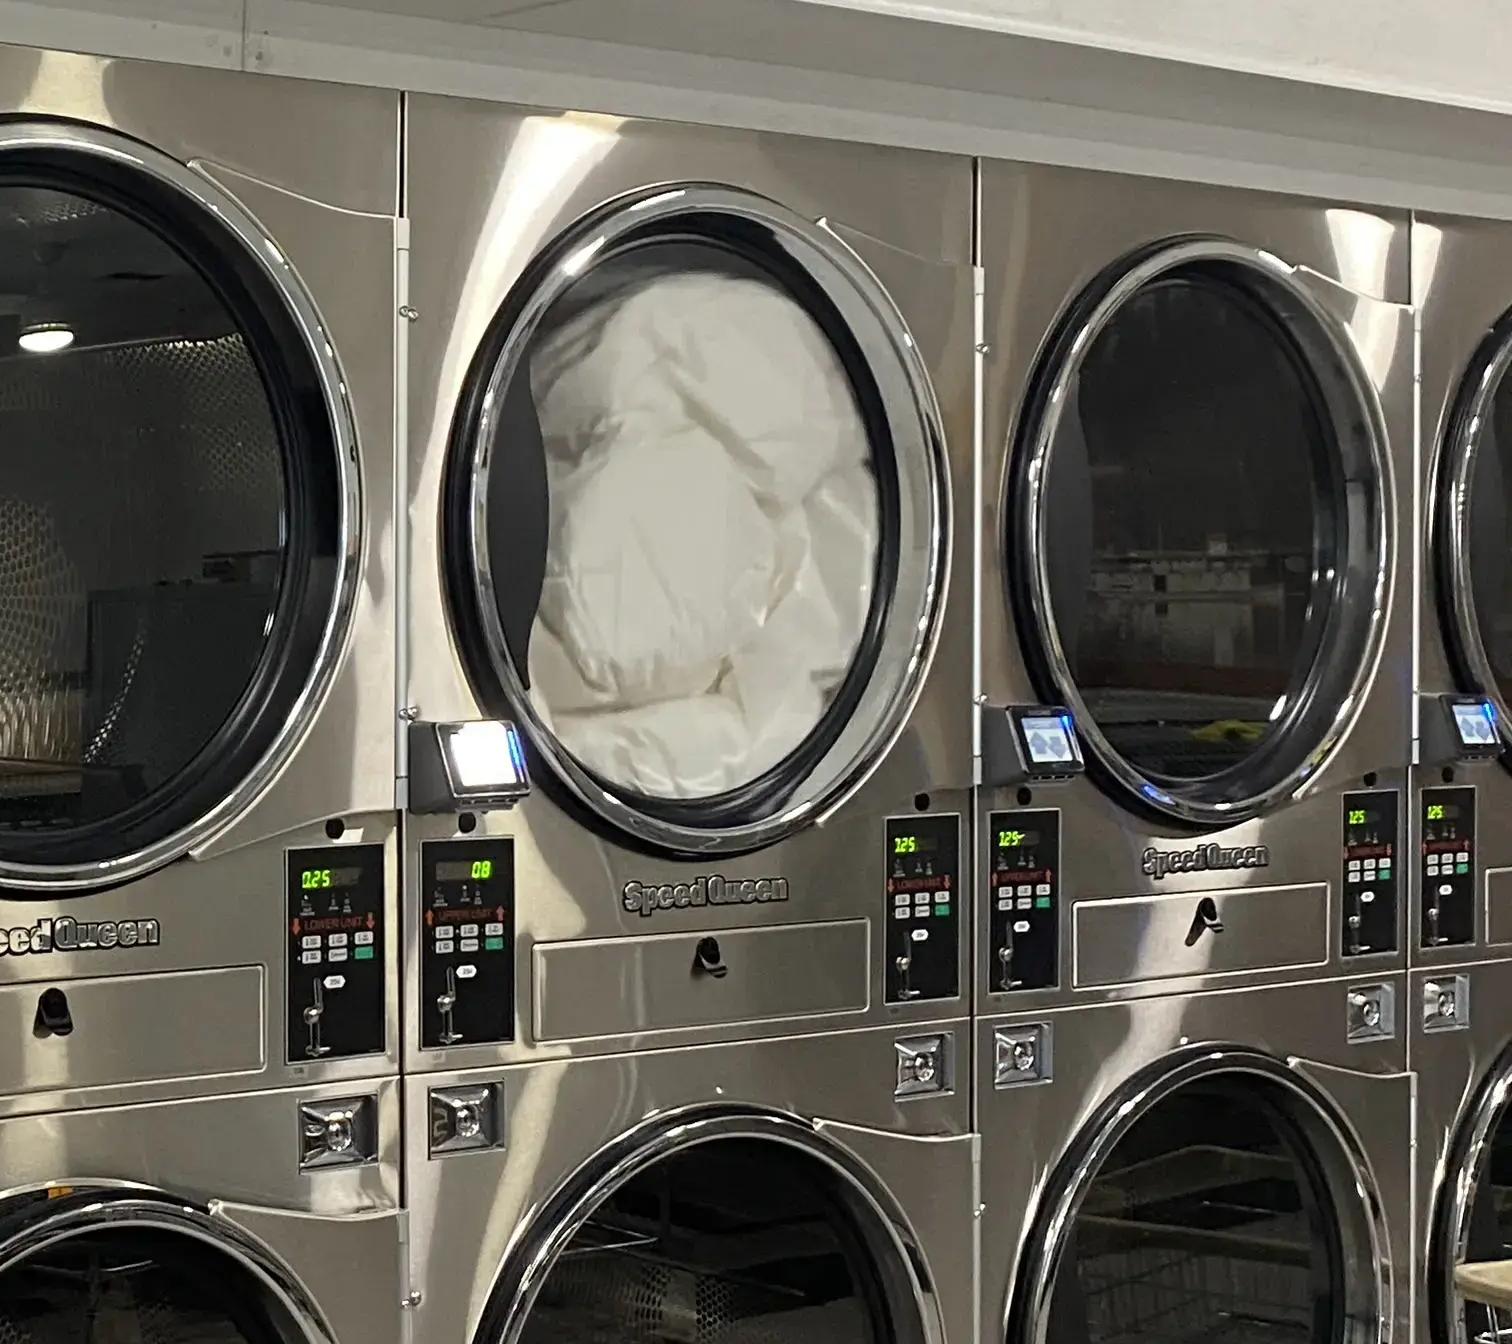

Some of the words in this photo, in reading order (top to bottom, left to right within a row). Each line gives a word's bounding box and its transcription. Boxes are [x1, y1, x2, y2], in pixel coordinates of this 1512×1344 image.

[1142, 844, 1208, 880] Speed
[1207, 842, 1269, 871] Queen
[623, 876, 707, 917] Speed
[707, 874, 789, 905] Queen
[53, 916, 161, 951] Queen
[303, 918, 341, 932] LOWER
